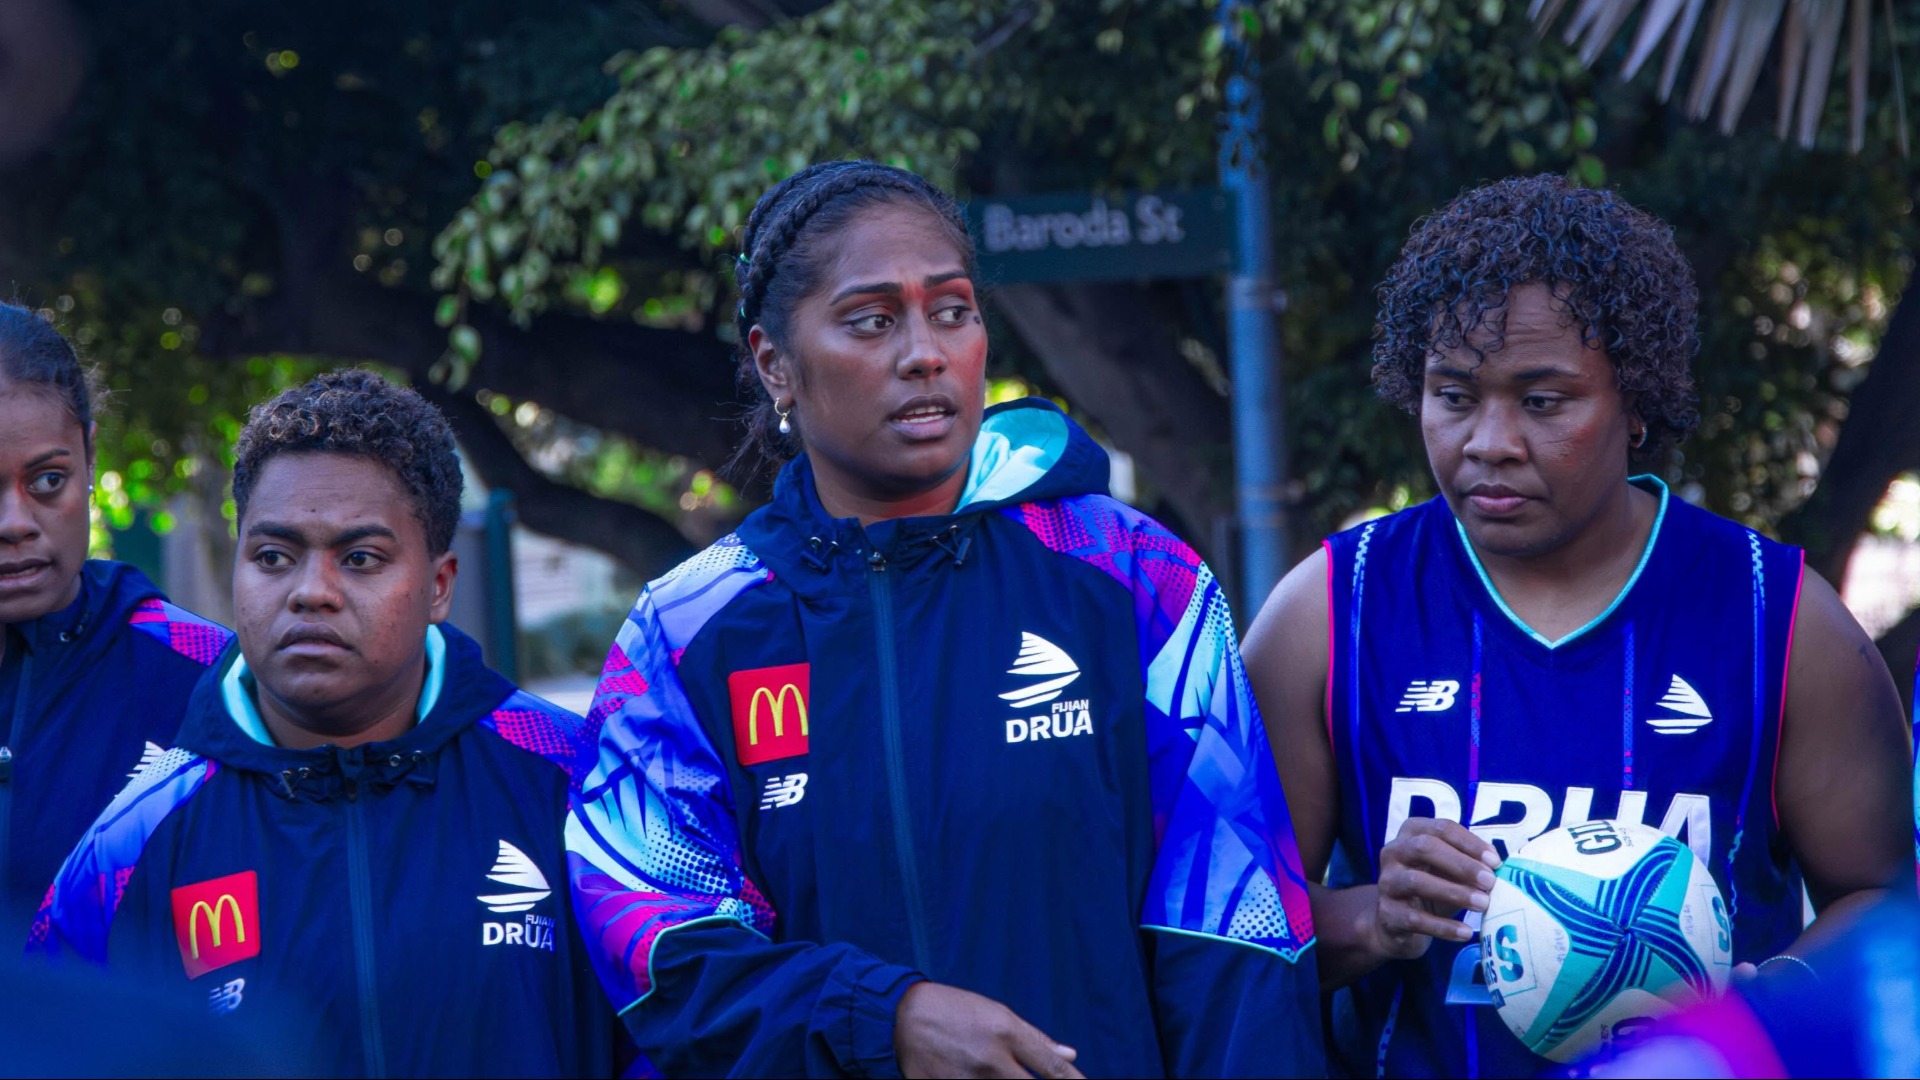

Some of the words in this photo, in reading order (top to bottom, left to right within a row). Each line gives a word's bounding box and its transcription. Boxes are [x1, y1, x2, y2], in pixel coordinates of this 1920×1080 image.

[984, 199, 1130, 248] Baroda
[1136, 195, 1185, 244] St
[1052, 699, 1089, 713] FIJIAN
[1006, 710, 1093, 743] DRUA
[483, 922, 554, 952] DRUA
